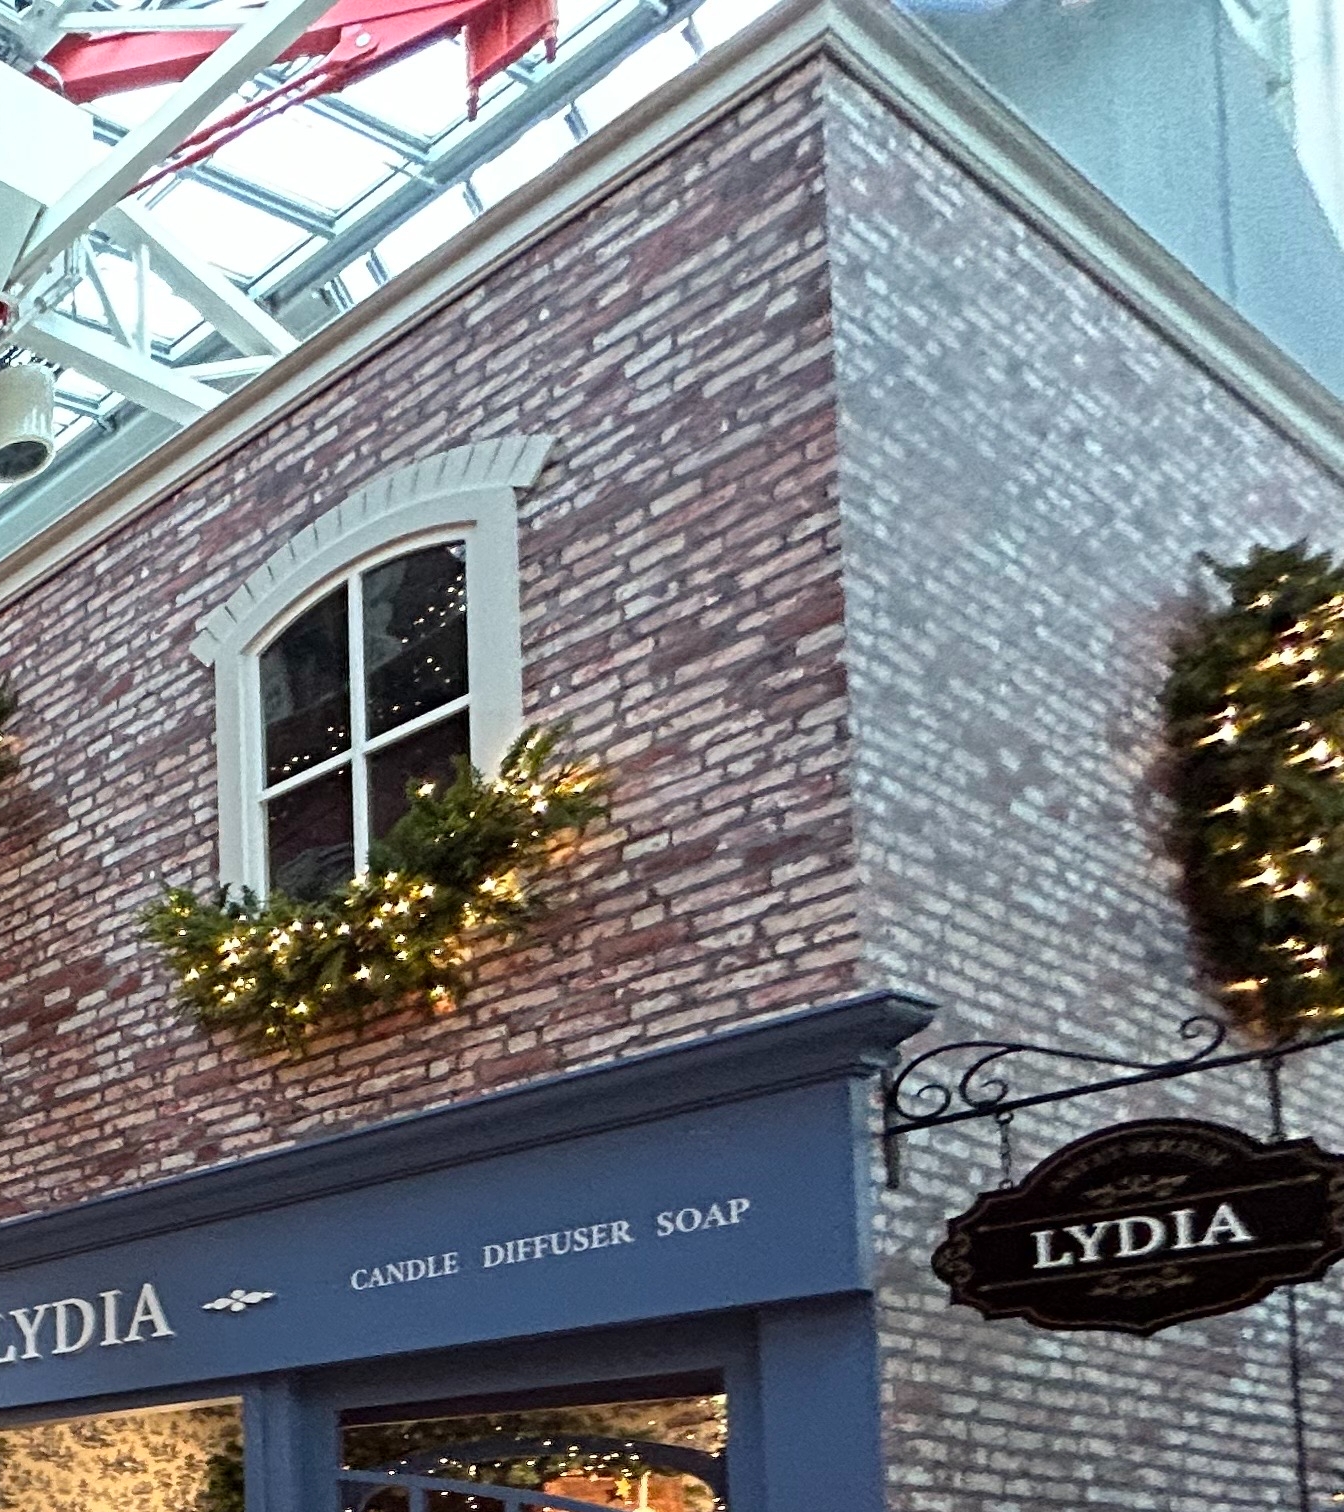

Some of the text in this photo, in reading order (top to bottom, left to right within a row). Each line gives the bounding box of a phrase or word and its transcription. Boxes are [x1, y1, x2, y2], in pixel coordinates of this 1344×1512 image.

[349, 1197, 751, 1291] CANDLE DIFFUSER SOAP
[1030, 1201, 1257, 1270] LYDIA
